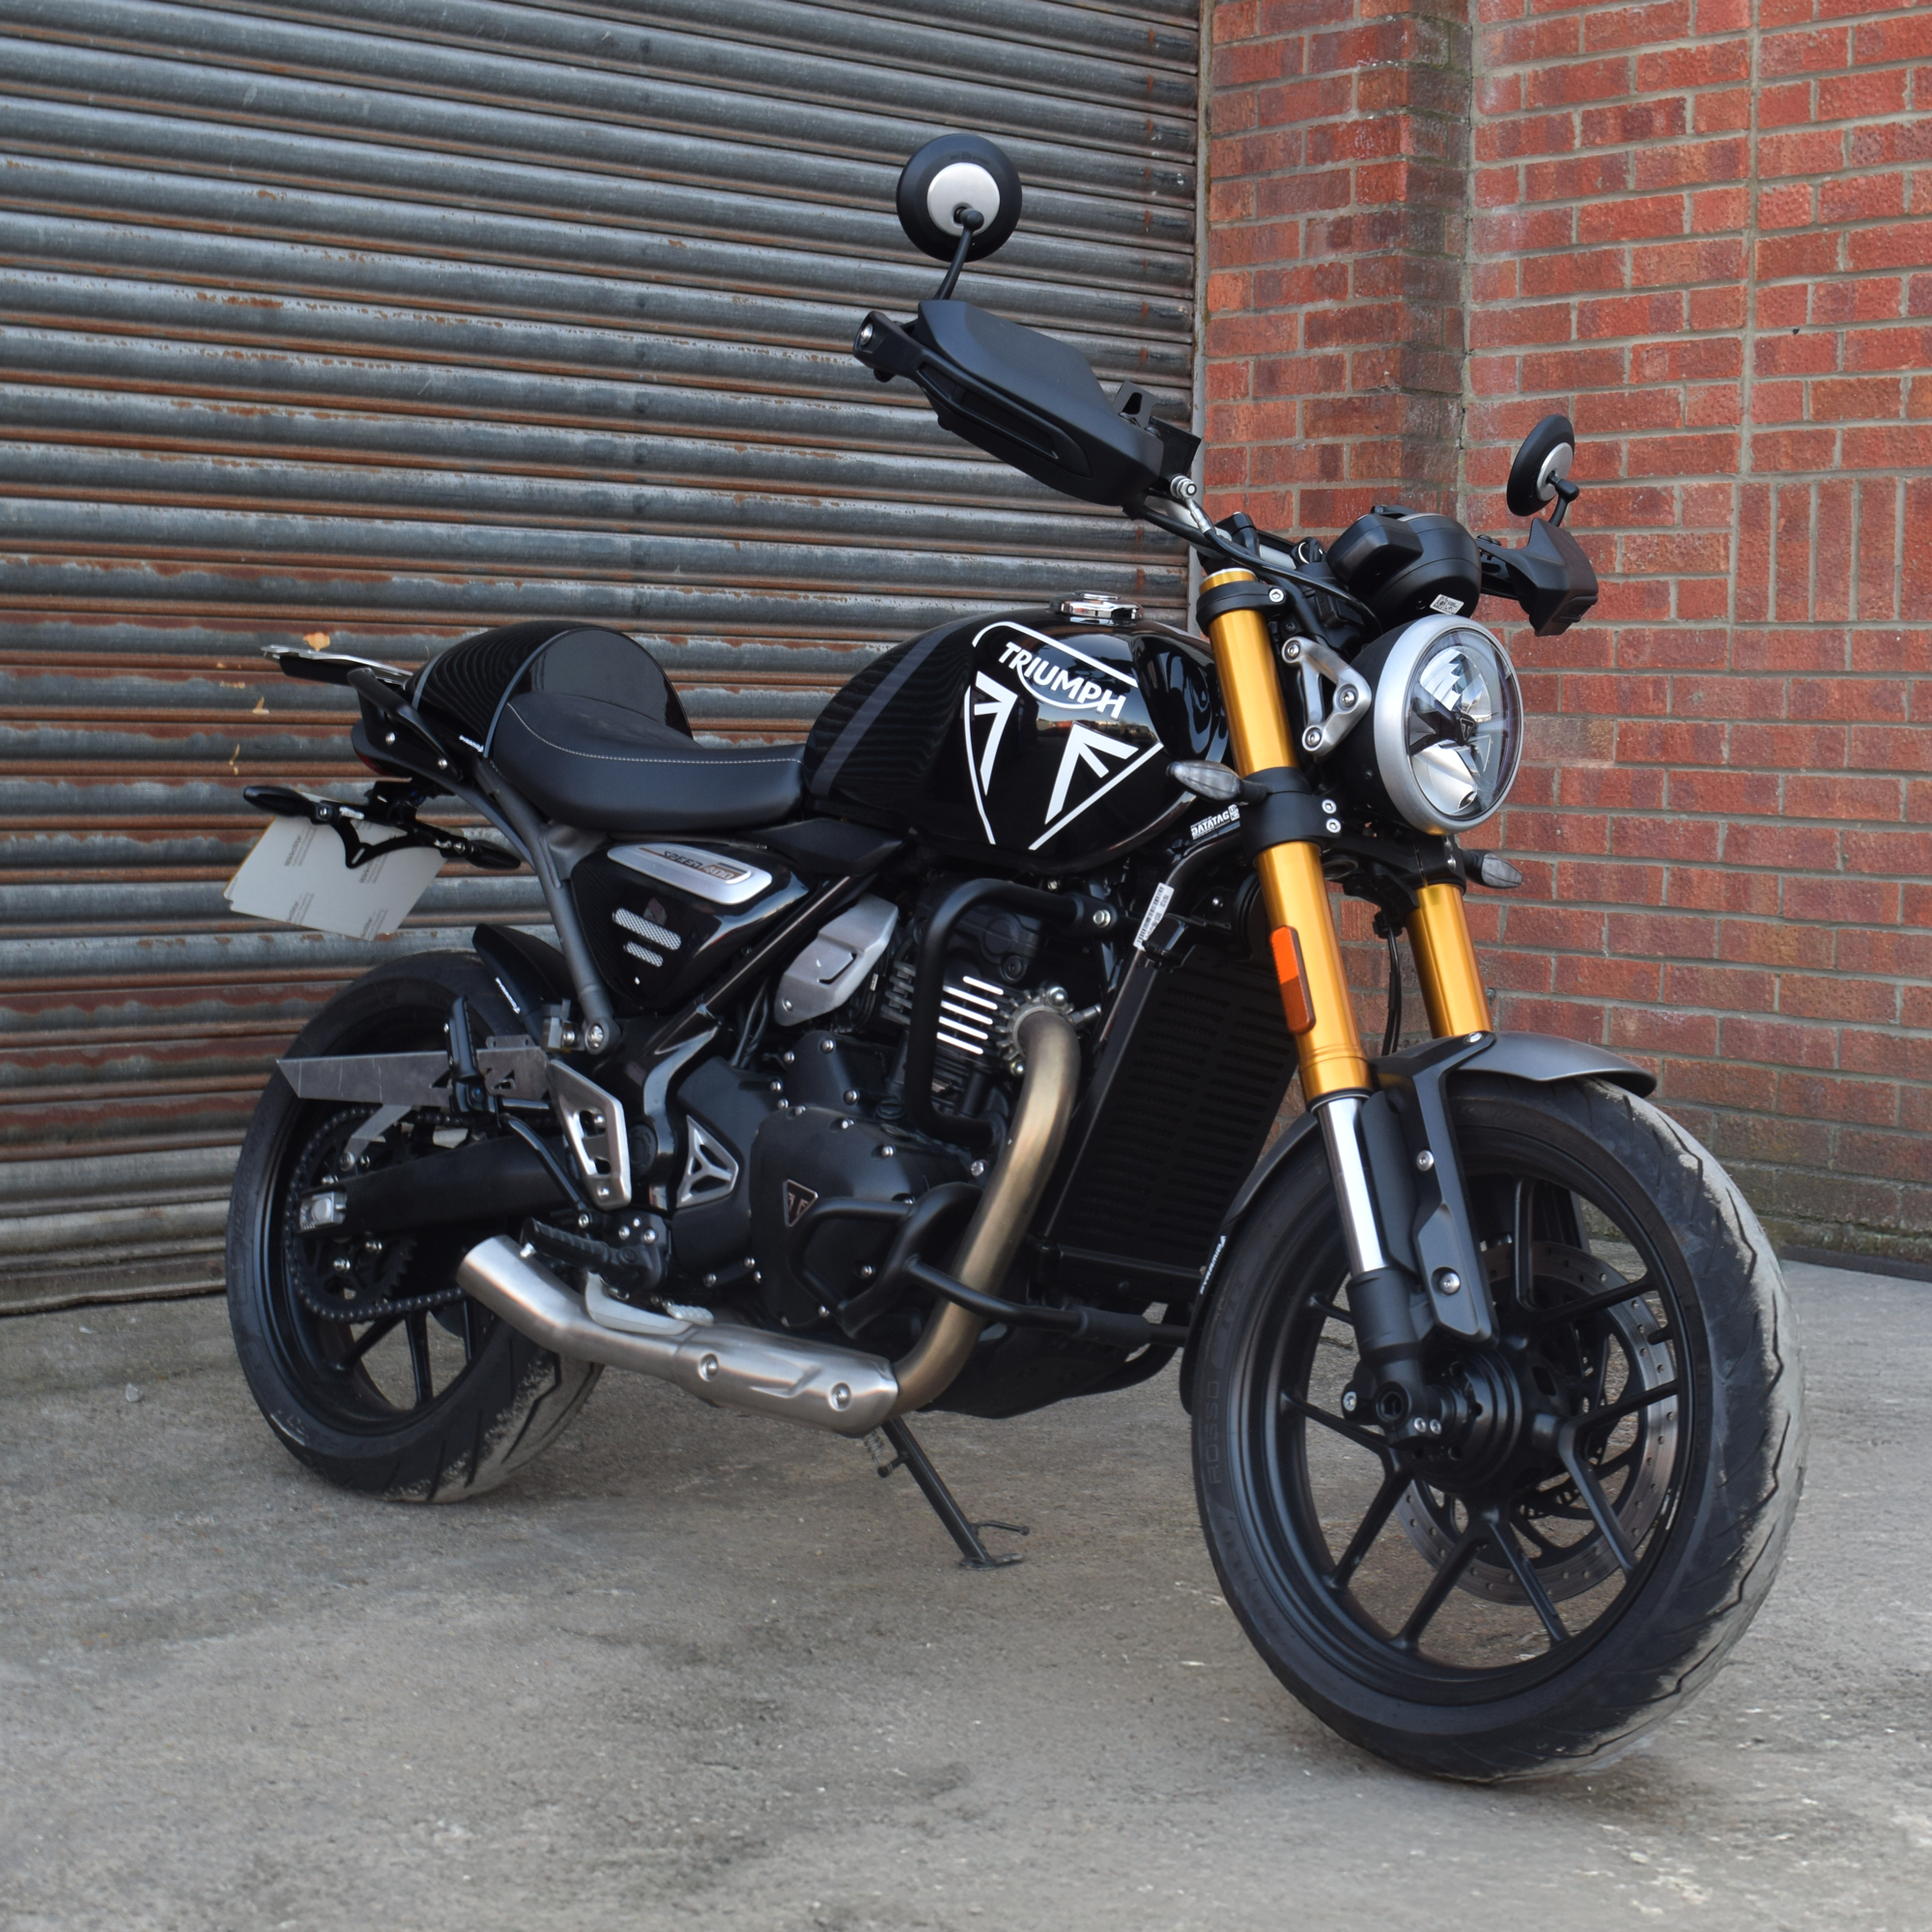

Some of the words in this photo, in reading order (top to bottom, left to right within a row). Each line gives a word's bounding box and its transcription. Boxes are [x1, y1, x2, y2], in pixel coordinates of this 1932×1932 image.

[998, 641, 1126, 721] TRIUMPH
[1191, 810, 1230, 837] DATATAG
[664, 851, 703, 868] SPEED
[704, 866, 735, 880] 400
[1208, 1380, 1221, 1485] ROSSO
